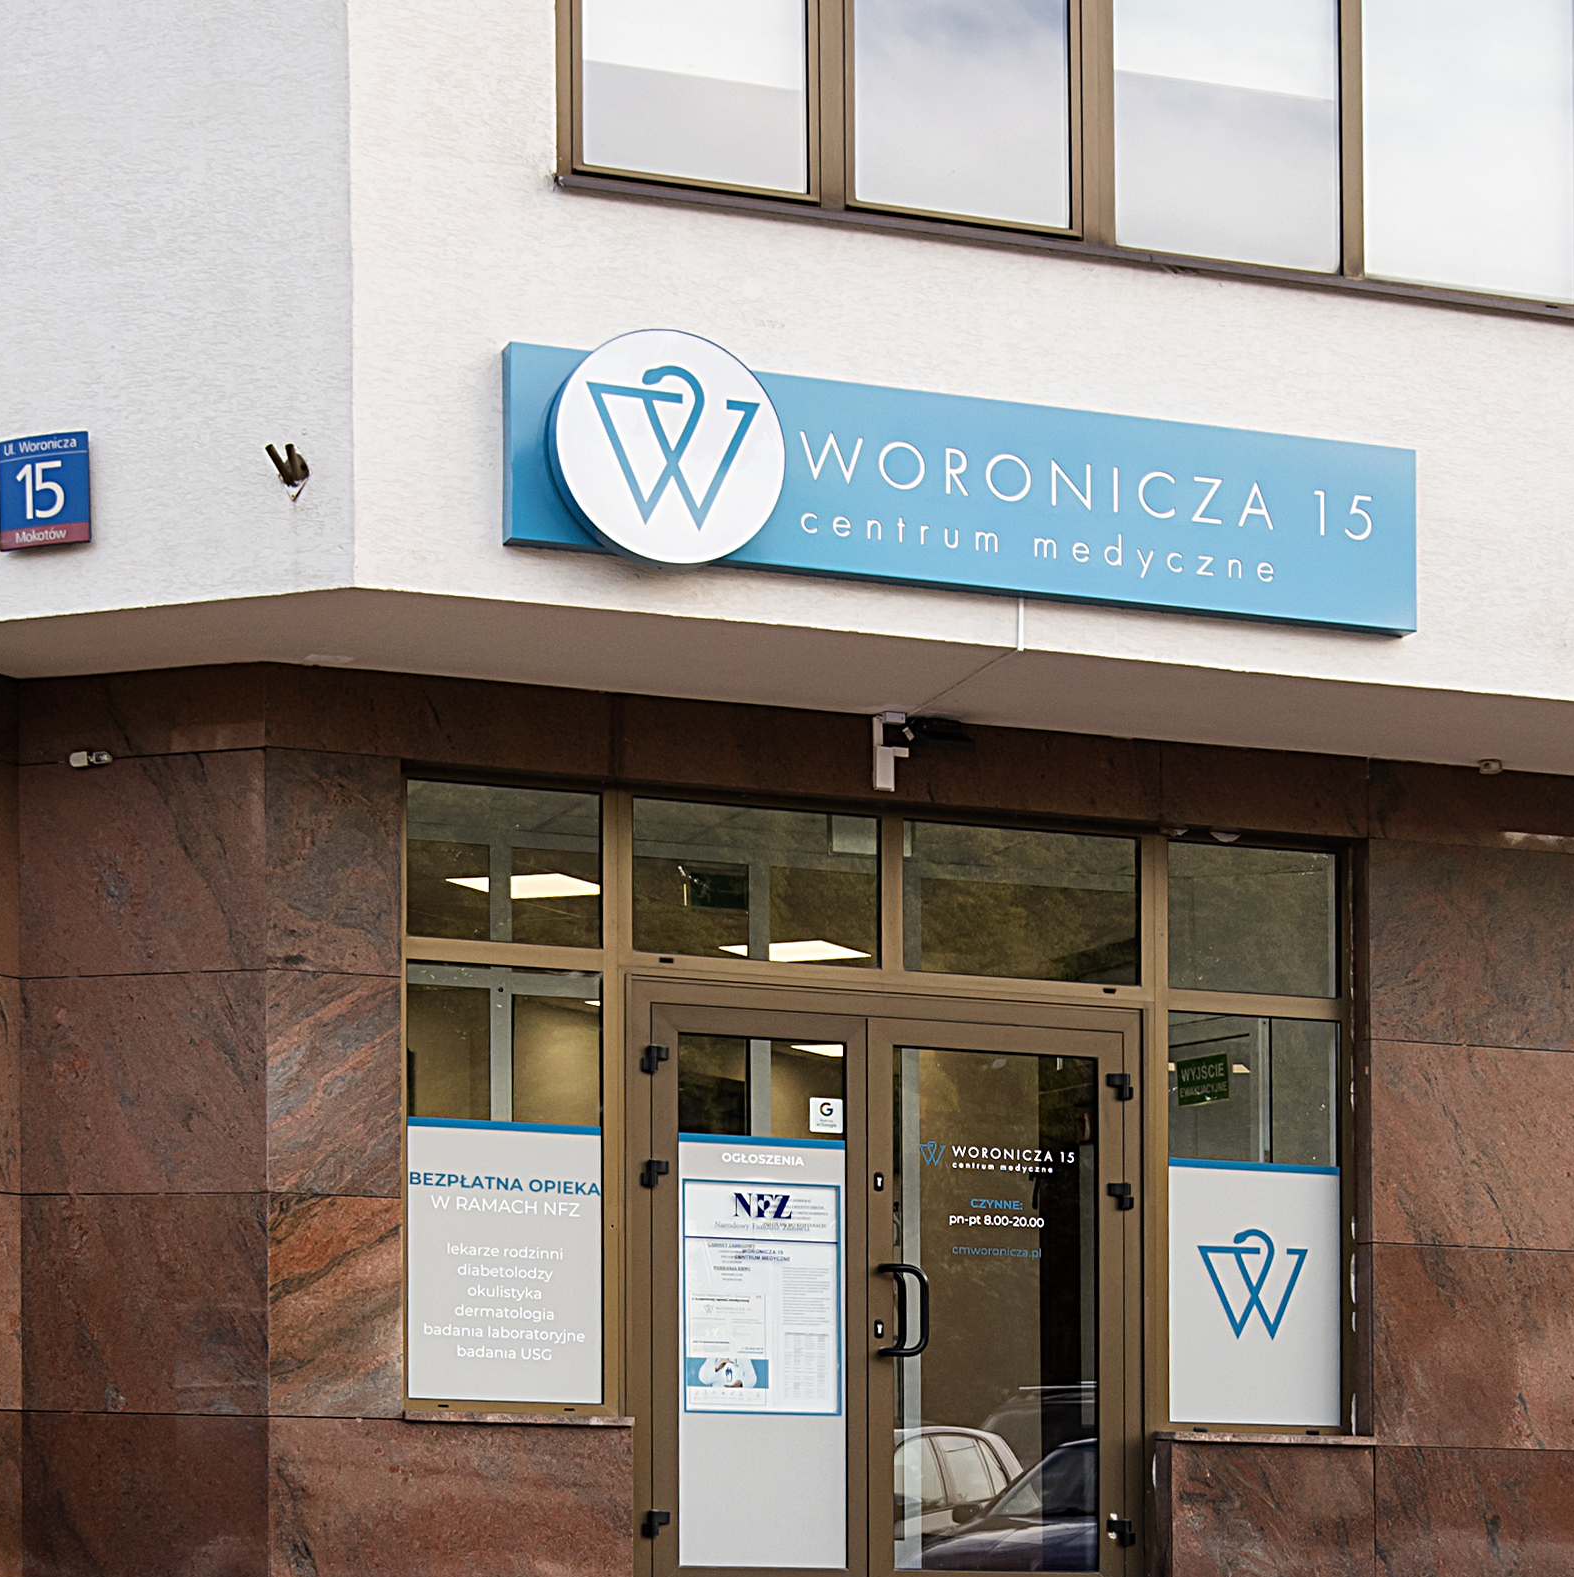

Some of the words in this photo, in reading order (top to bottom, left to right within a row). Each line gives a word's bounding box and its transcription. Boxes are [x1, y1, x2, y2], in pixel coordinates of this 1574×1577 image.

[19, 437, 77, 453] Woronicza
[16, 460, 65, 520] 15
[799, 430, 1277, 531] WORONICZA
[1312, 489, 1374, 541] 15
[15, 527, 67, 544] Mokotów
[799, 511, 1000, 553] centrum
[1033, 526, 1278, 583] medyczne
[1181, 1062, 1225, 1082] WYJŚCIE
[721, 1152, 805, 1167] OGŁOSZENIA
[952, 1145, 1054, 1163] WORONICZA
[1060, 1151, 1075, 1164] 15
[951, 1161, 995, 1171] centrum
[1000, 1163, 1054, 1174] medyczne
[409, 1171, 524, 1192] BEZPŁATNA
[529, 1179, 601, 1197] OPIEKA
[430, 1195, 450, 1210] W
[456, 1197, 538, 1215] RAMACH
[544, 1201, 581, 1218] NFZ
[732, 1191, 793, 1220] NFZ
[969, 1198, 1024, 1211] CZYNNE:
[948, 1214, 982, 1227] pn-pt
[983, 1214, 1045, 1228] 8.00-20.00
[446, 1242, 500, 1257] lekarze
[503, 1247, 564, 1260] rodzinni
[951, 1244, 1042, 1259] cmworonicza.pl
[457, 1263, 554, 1283] diabetolodzy
[467, 1284, 542, 1301] okulistyka
[454, 1304, 555, 1323] dermatologia
[423, 1322, 484, 1338] badania
[487, 1325, 586, 1344] laboratoryjne
[456, 1345, 517, 1360] badania
[520, 1347, 553, 1361] USG
